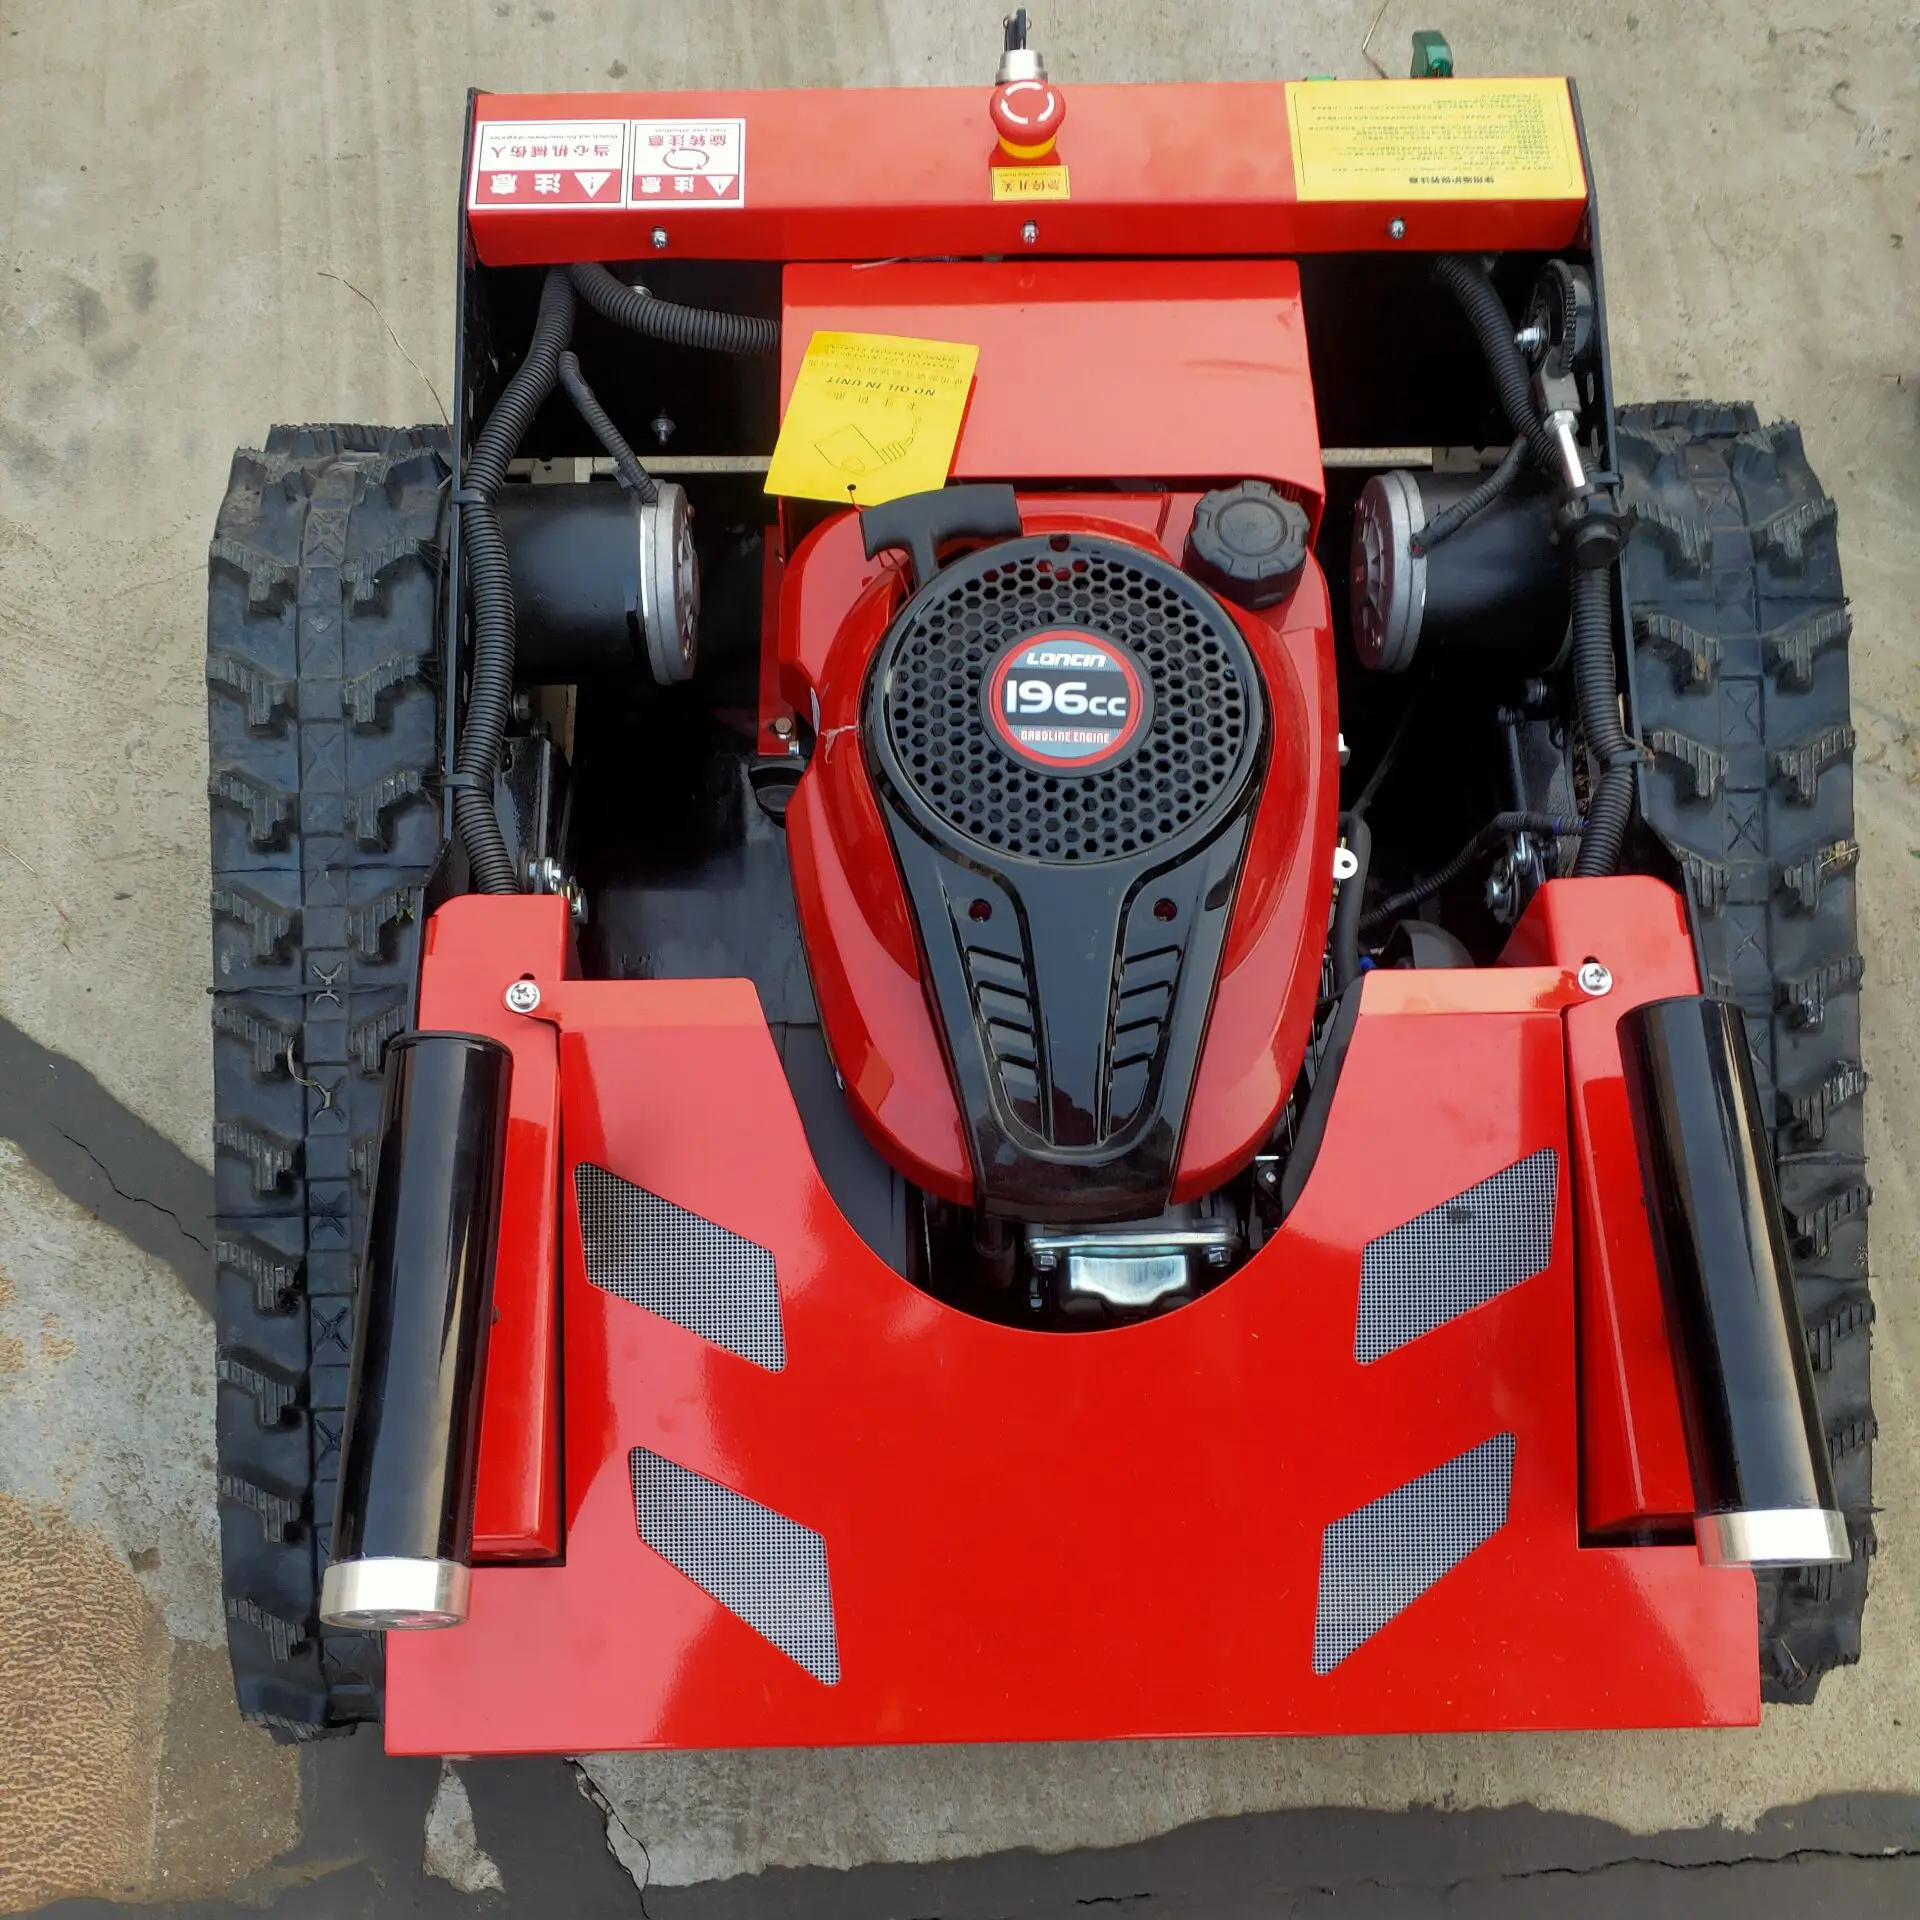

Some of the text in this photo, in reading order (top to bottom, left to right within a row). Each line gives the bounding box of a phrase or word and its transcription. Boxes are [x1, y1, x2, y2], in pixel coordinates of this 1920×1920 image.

[490, 144, 611, 159] 当心机械伤人
[490, 173, 562, 194] 注意
[641, 176, 695, 194] 注意
[825, 376, 937, 397] NO OIL IN UNIT
[1006, 679, 1127, 717] 196cc
[1020, 730, 1111, 744] GASOLINE ENGINE
